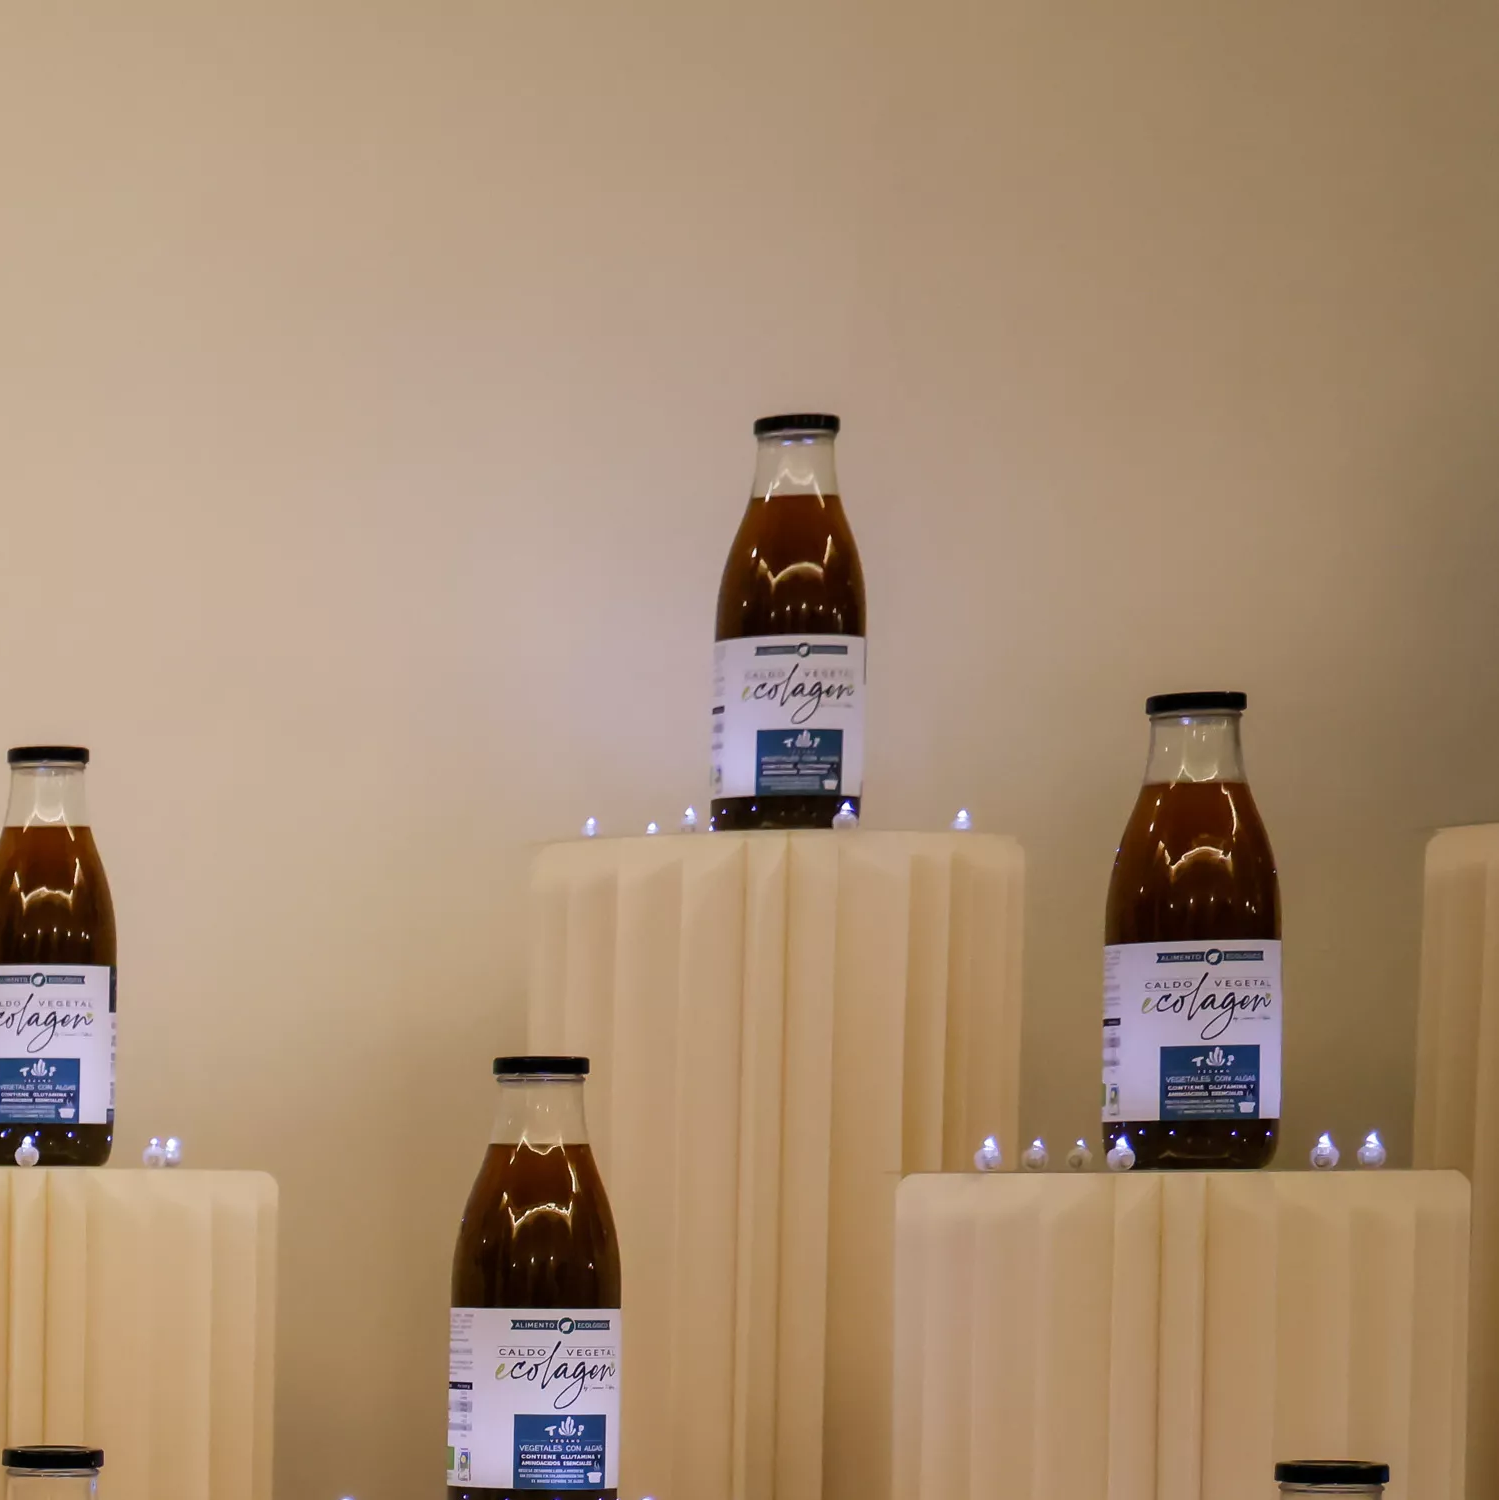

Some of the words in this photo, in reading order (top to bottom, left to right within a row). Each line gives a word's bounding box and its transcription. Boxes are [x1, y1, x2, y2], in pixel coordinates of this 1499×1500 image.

[1145, 981, 1192, 989] CALDO
[1215, 979, 1271, 987] VEGETAL
[1165, 1075, 1210, 1083] VEGETALES
[499, 1348, 546, 1356] CALDO
[567, 1348, 614, 1356] VEGETAL
